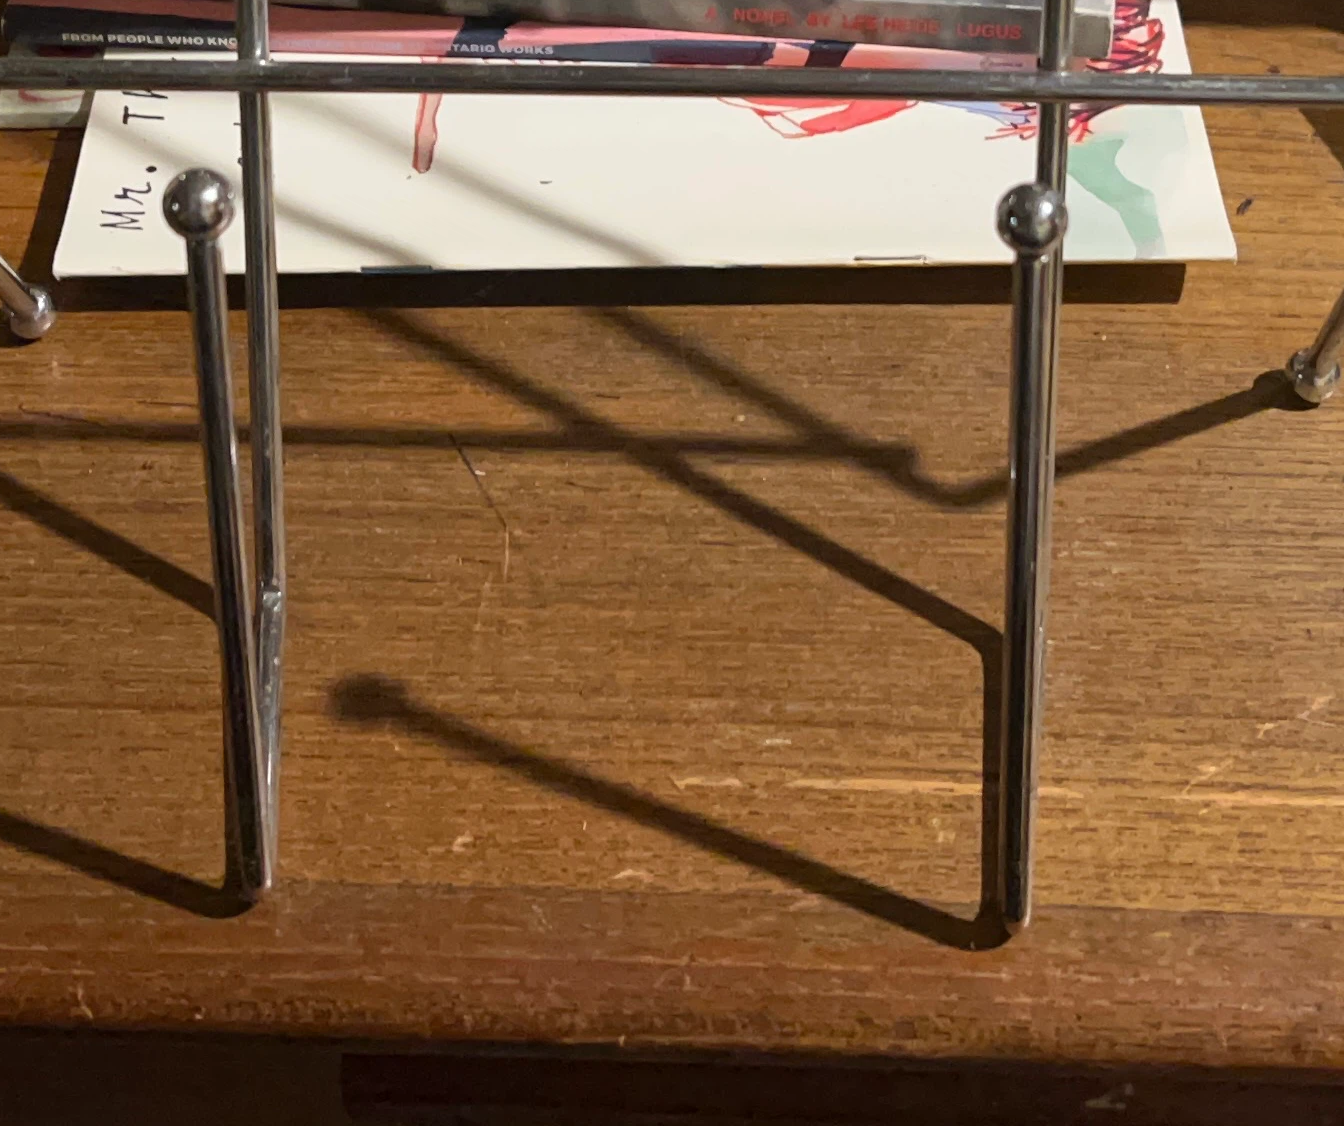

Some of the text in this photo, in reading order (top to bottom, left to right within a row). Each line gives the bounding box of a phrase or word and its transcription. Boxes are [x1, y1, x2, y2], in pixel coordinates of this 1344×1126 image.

[956, 22, 1023, 40] LUGUS
[61, 32, 555, 56] FROM PEOPLE WHO KNO WORKS
[99, 165, 158, 231] Mr.
